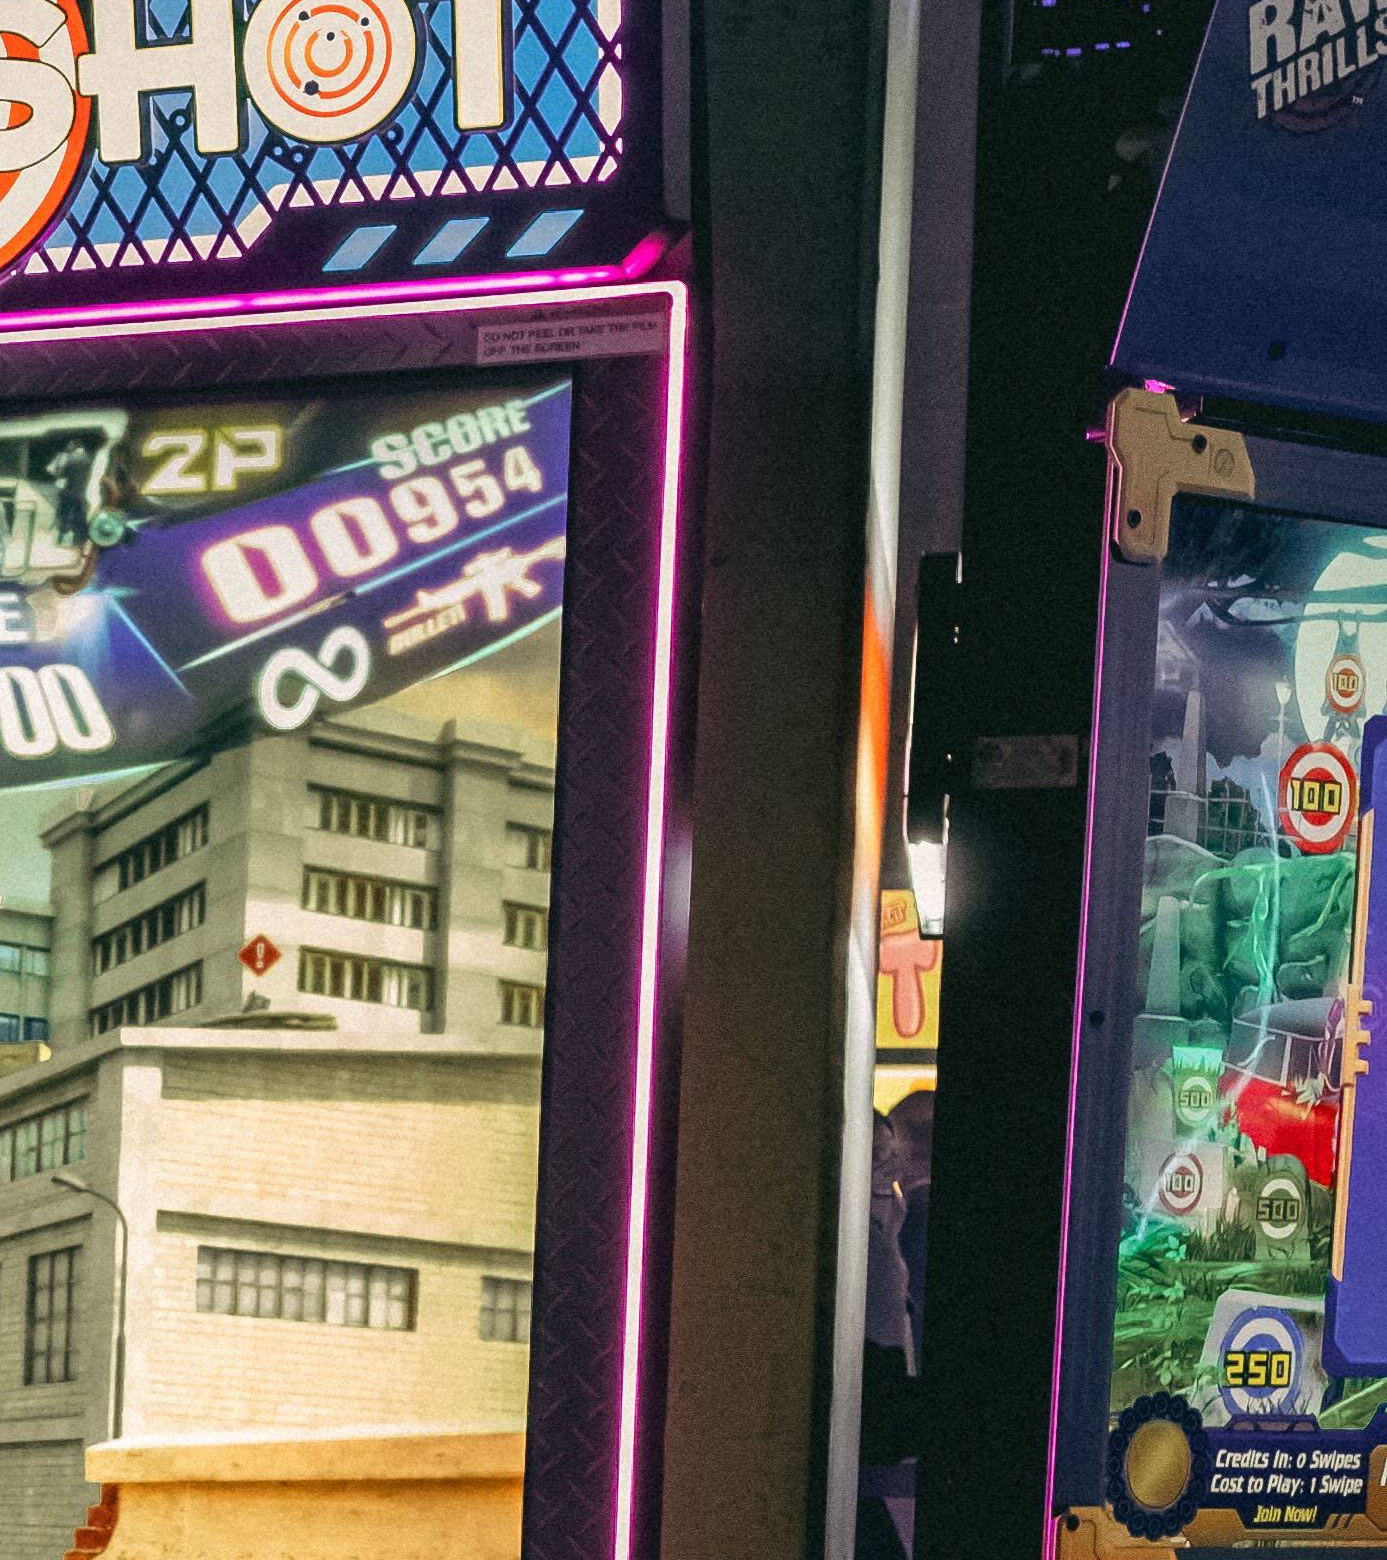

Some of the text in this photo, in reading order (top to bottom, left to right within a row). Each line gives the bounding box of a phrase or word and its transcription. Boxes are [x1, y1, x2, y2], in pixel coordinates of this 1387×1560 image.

[1251, 13, 1387, 119] THRILLS
[370, 399, 531, 480] SCORE
[141, 427, 282, 494] 2P
[201, 446, 542, 623] 00954
[1291, 777, 1342, 815] 100
[1179, 1089, 1212, 1108] 500
[1258, 1198, 1299, 1222] 500
[1226, 1351, 1291, 1387] 250
[1215, 1449, 1269, 1469] Credits
[1310, 1450, 1361, 1472] Swipes
[1210, 1474, 1244, 1493] Cost
[1247, 1475, 1264, 1493] to
[1319, 1475, 1363, 1497] Swipe
[1254, 1505, 1318, 1523] Join Now!
